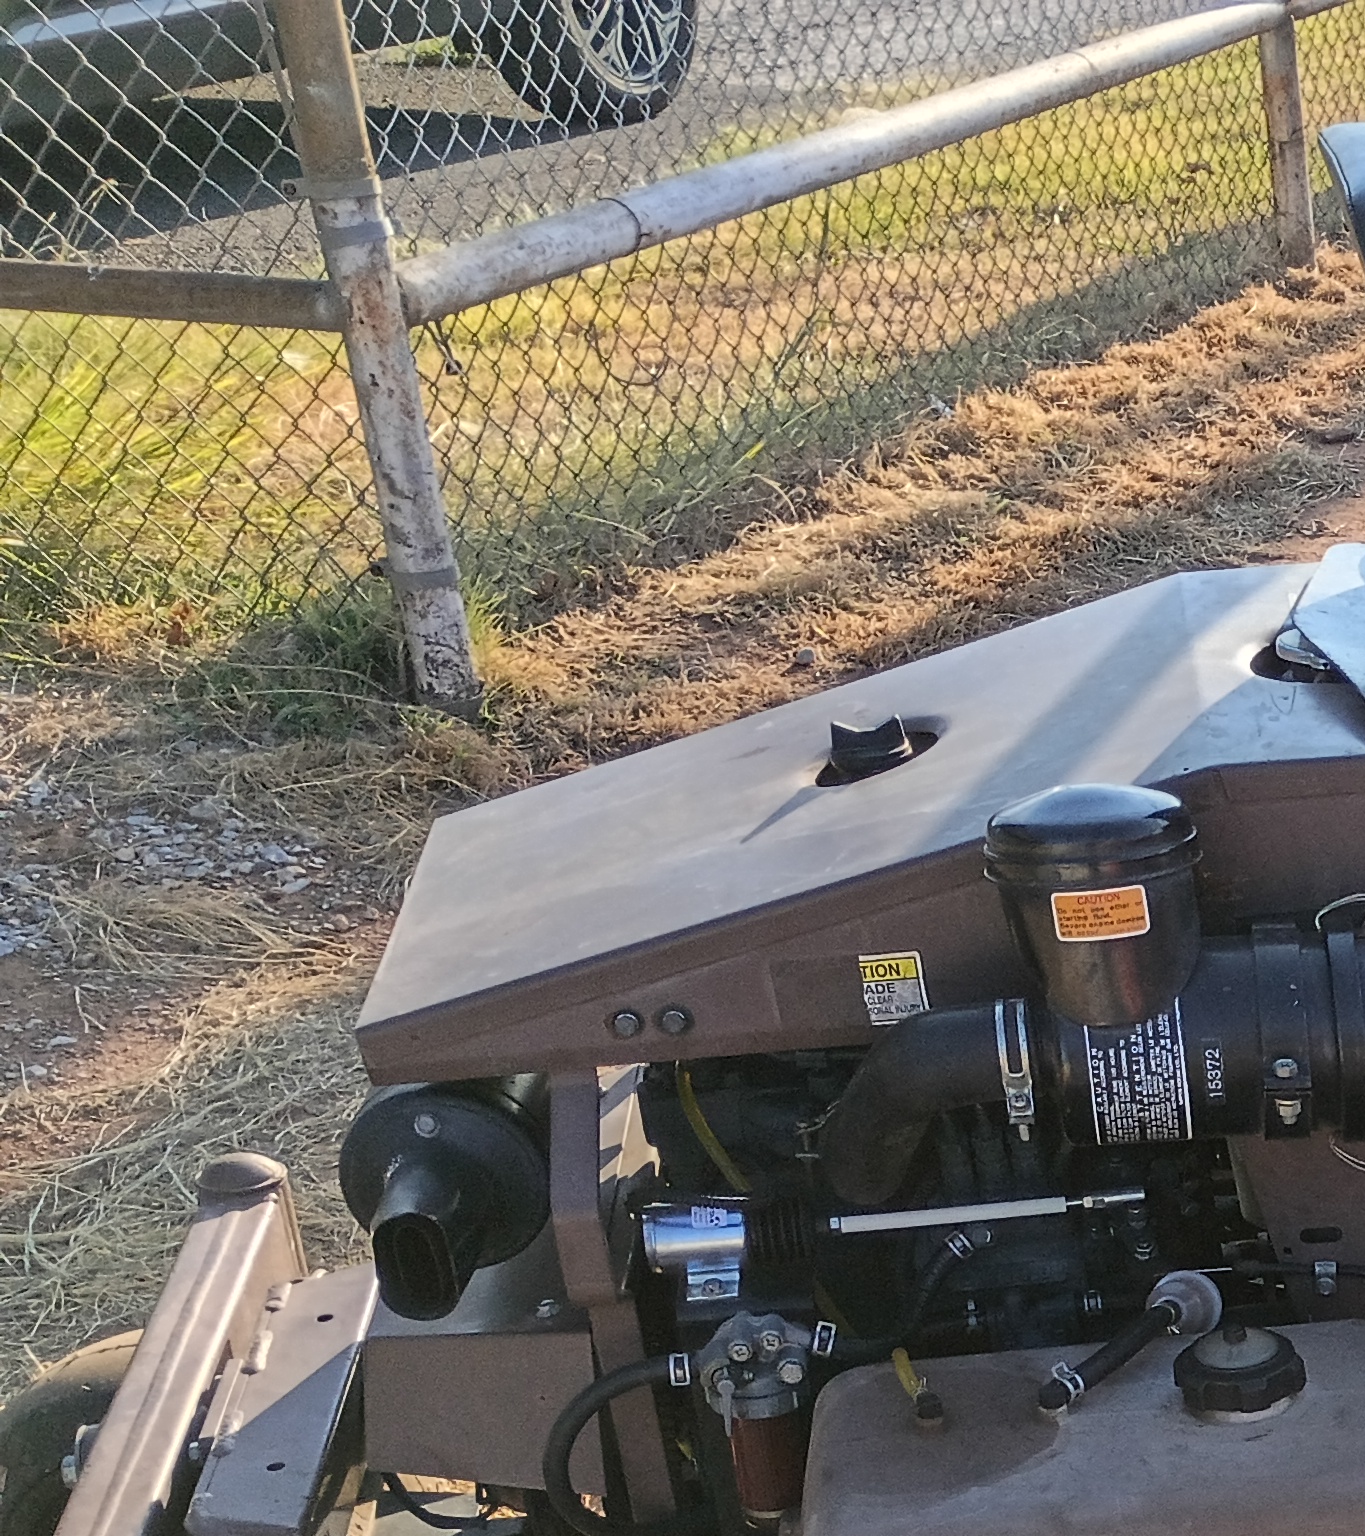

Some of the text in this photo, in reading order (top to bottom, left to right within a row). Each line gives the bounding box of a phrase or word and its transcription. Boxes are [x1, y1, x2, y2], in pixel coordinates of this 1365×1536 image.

[1077, 893, 1121, 905] CAUTION
[860, 963, 901, 979] TION
[865, 983, 896, 995] ADE
[1091, 1048, 1104, 1112] CAUTION
[1130, 1034, 1144, 1117] ATTENTION
[1204, 1048, 1224, 1098] 15372
